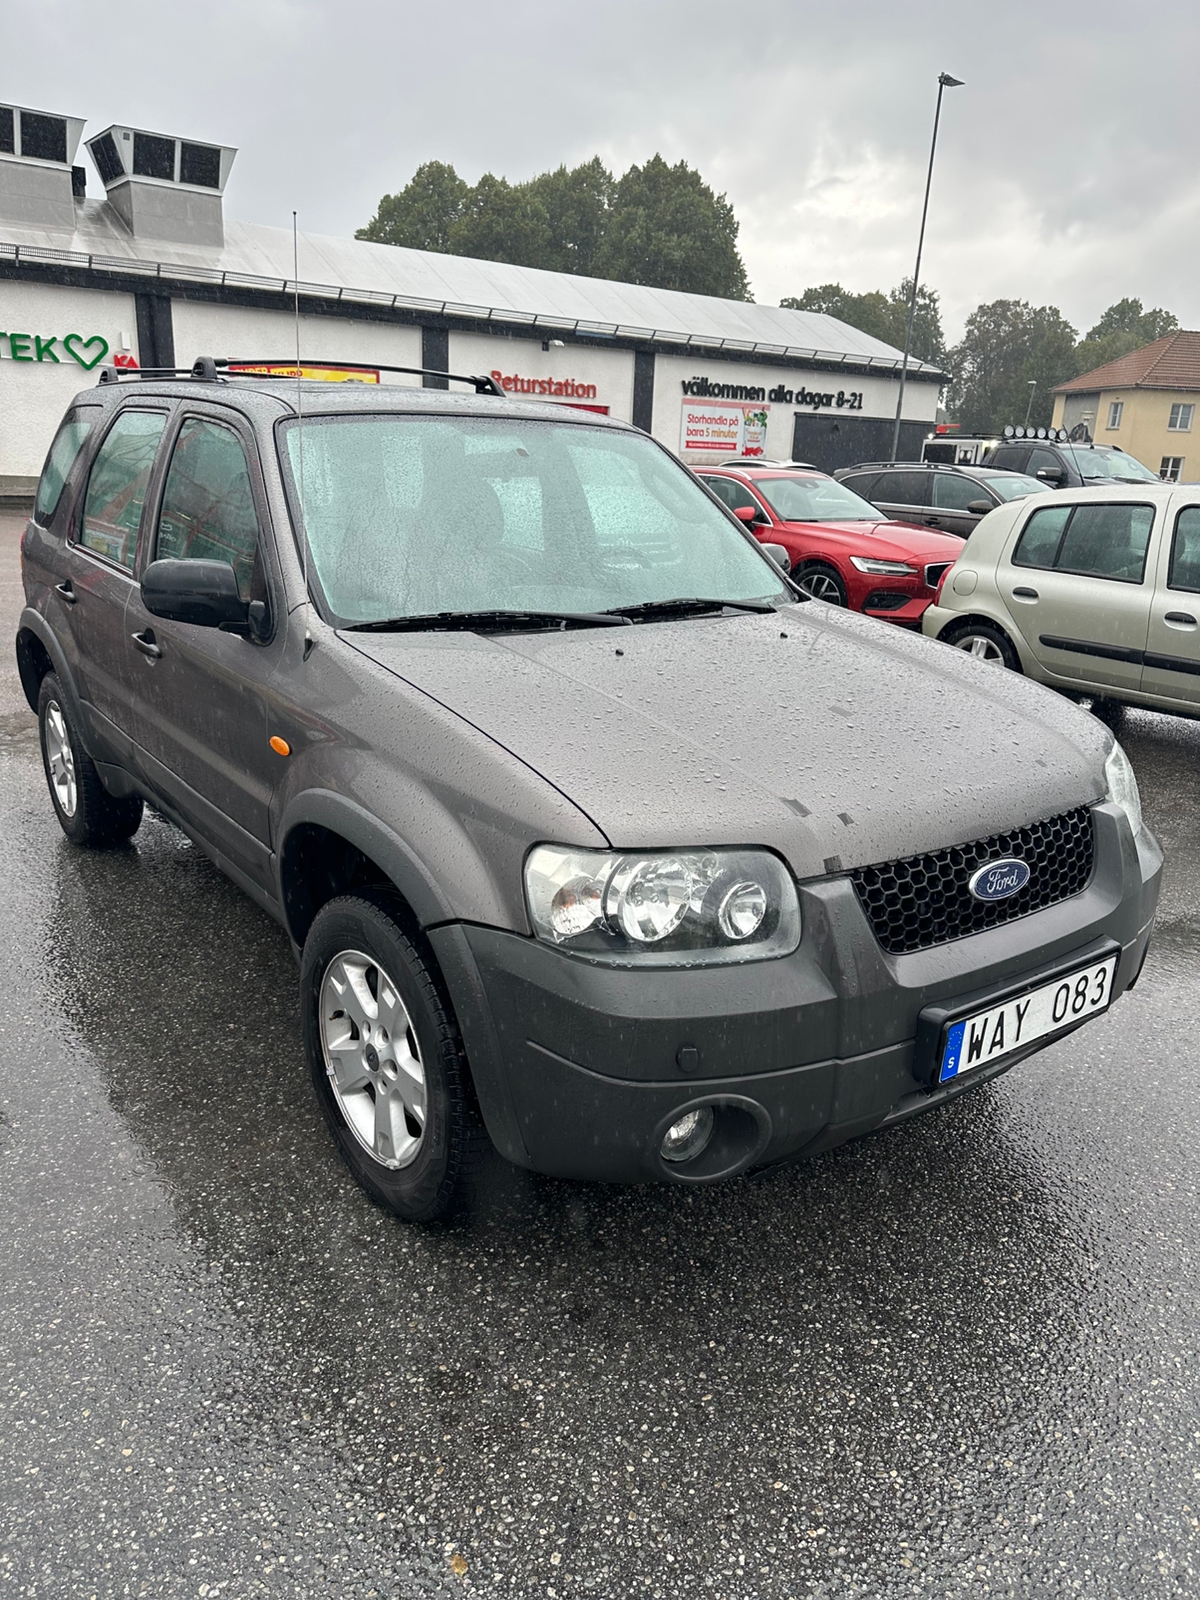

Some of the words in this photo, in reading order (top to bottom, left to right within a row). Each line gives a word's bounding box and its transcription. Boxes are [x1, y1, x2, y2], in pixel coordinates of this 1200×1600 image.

[113, 354, 139, 368] ICA
[491, 370, 597, 398] Returstation
[681, 376, 765, 401] välkommen
[769, 384, 793, 403] alla
[795, 387, 835, 410] dagar
[687, 413, 727, 426] Storhandla
[728, 415, 739, 428] på
[686, 426, 704, 437] bara
[705, 427, 710, 438] 5
[711, 428, 738, 439] minuter
[986, 865, 1019, 893] Ford
[967, 999, 1031, 1063] WAY
[1052, 967, 1107, 1023] 083
[947, 1056, 955, 1069] S
